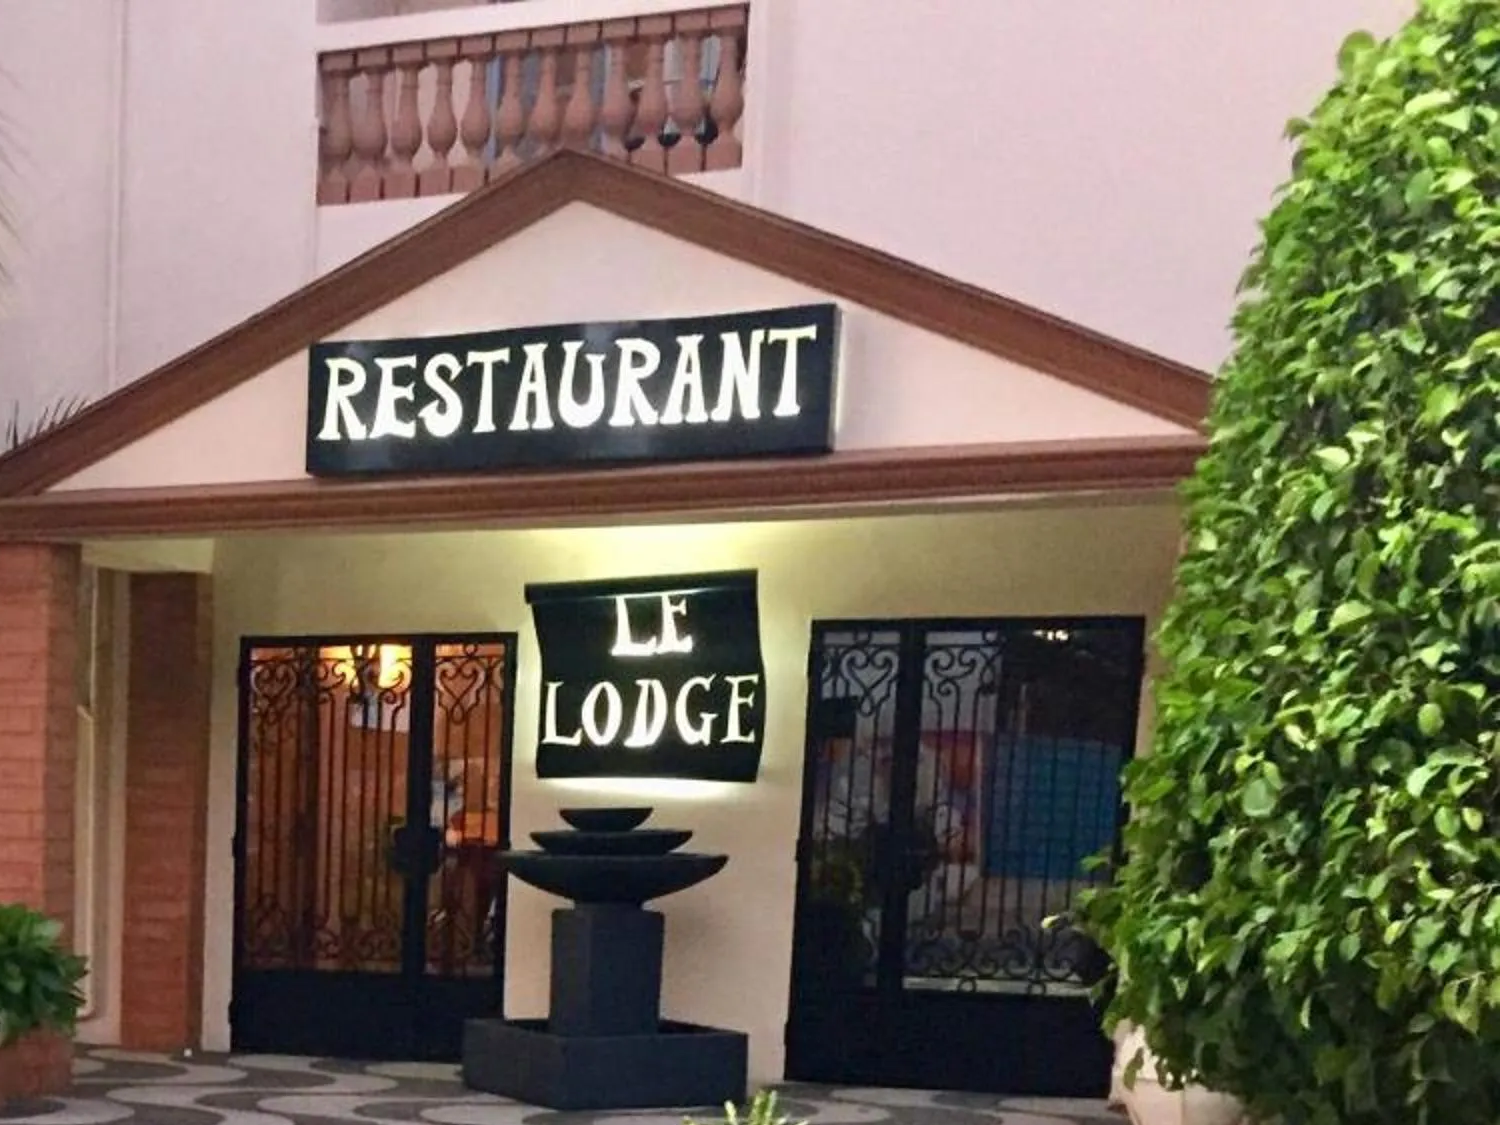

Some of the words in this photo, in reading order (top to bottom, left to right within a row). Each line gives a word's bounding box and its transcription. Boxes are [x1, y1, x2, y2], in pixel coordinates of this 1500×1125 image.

[318, 325, 817, 440] RESTAURANT
[611, 592, 693, 656] LE
[541, 674, 758, 747] LODGE
